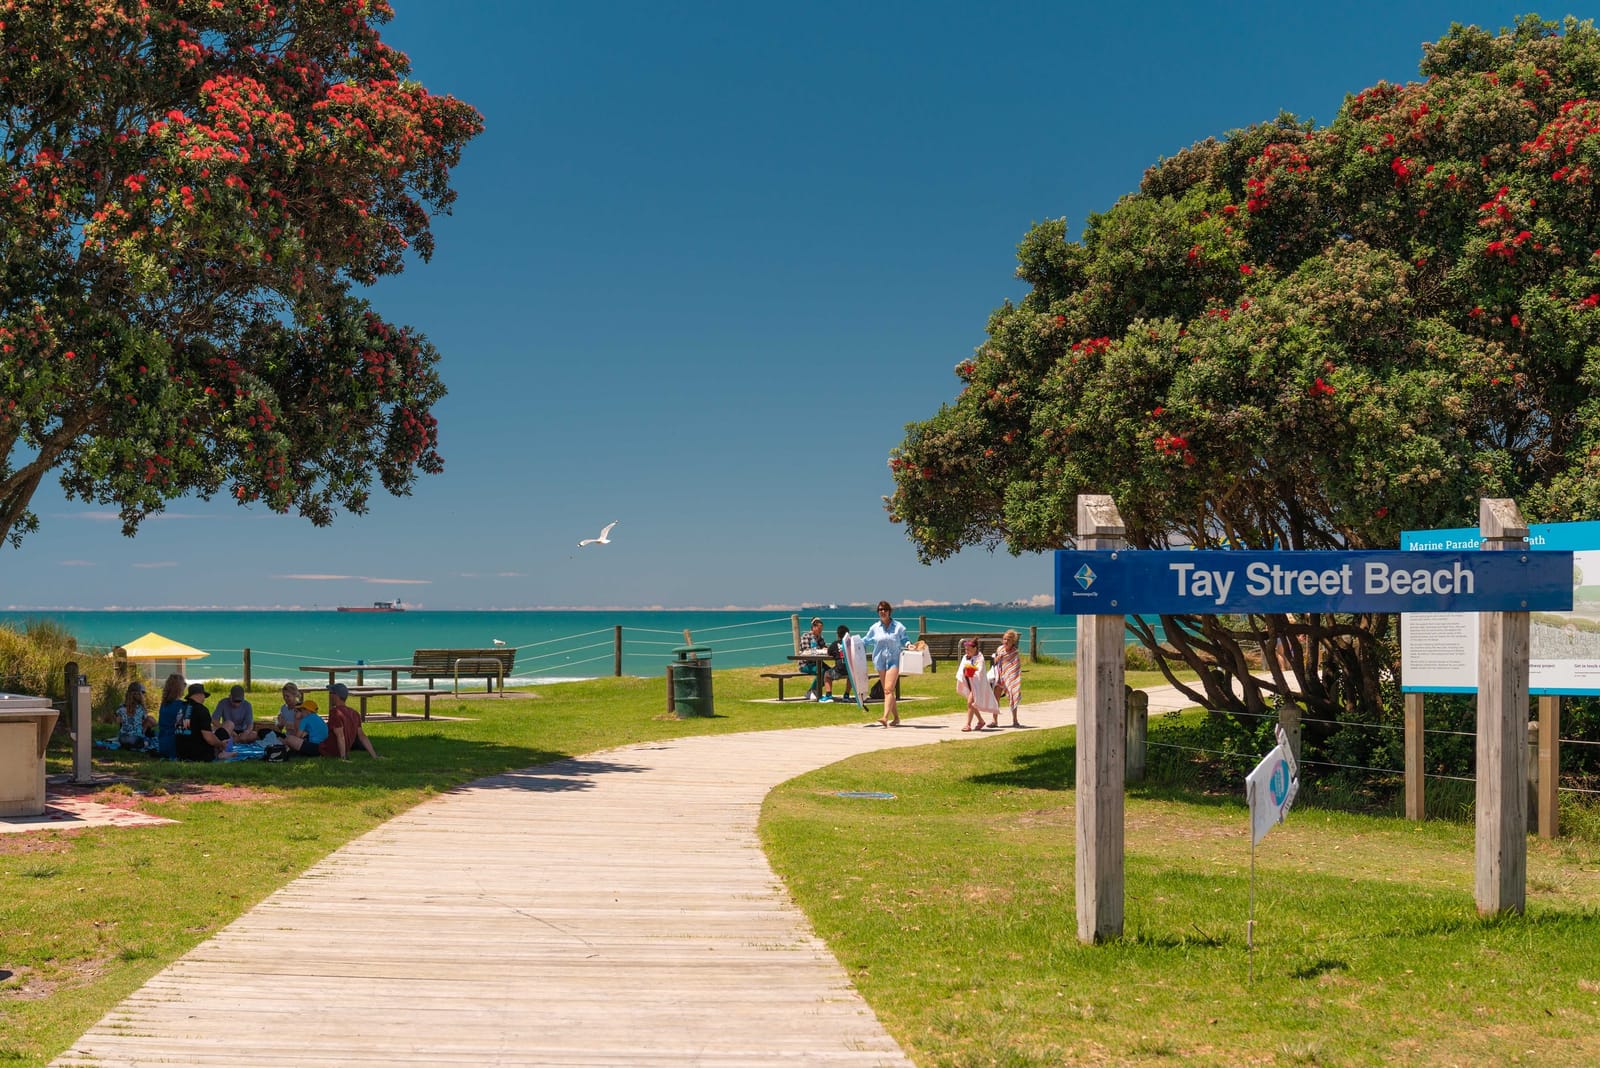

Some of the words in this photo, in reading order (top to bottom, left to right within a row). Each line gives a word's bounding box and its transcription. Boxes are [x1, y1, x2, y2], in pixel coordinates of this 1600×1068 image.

[1409, 540, 1443, 551] Marine
[1446, 538, 1479, 550] Parade
[1169, 563, 1235, 605] Tay
[1246, 562, 1353, 596] Street
[1364, 562, 1474, 595] Beach
